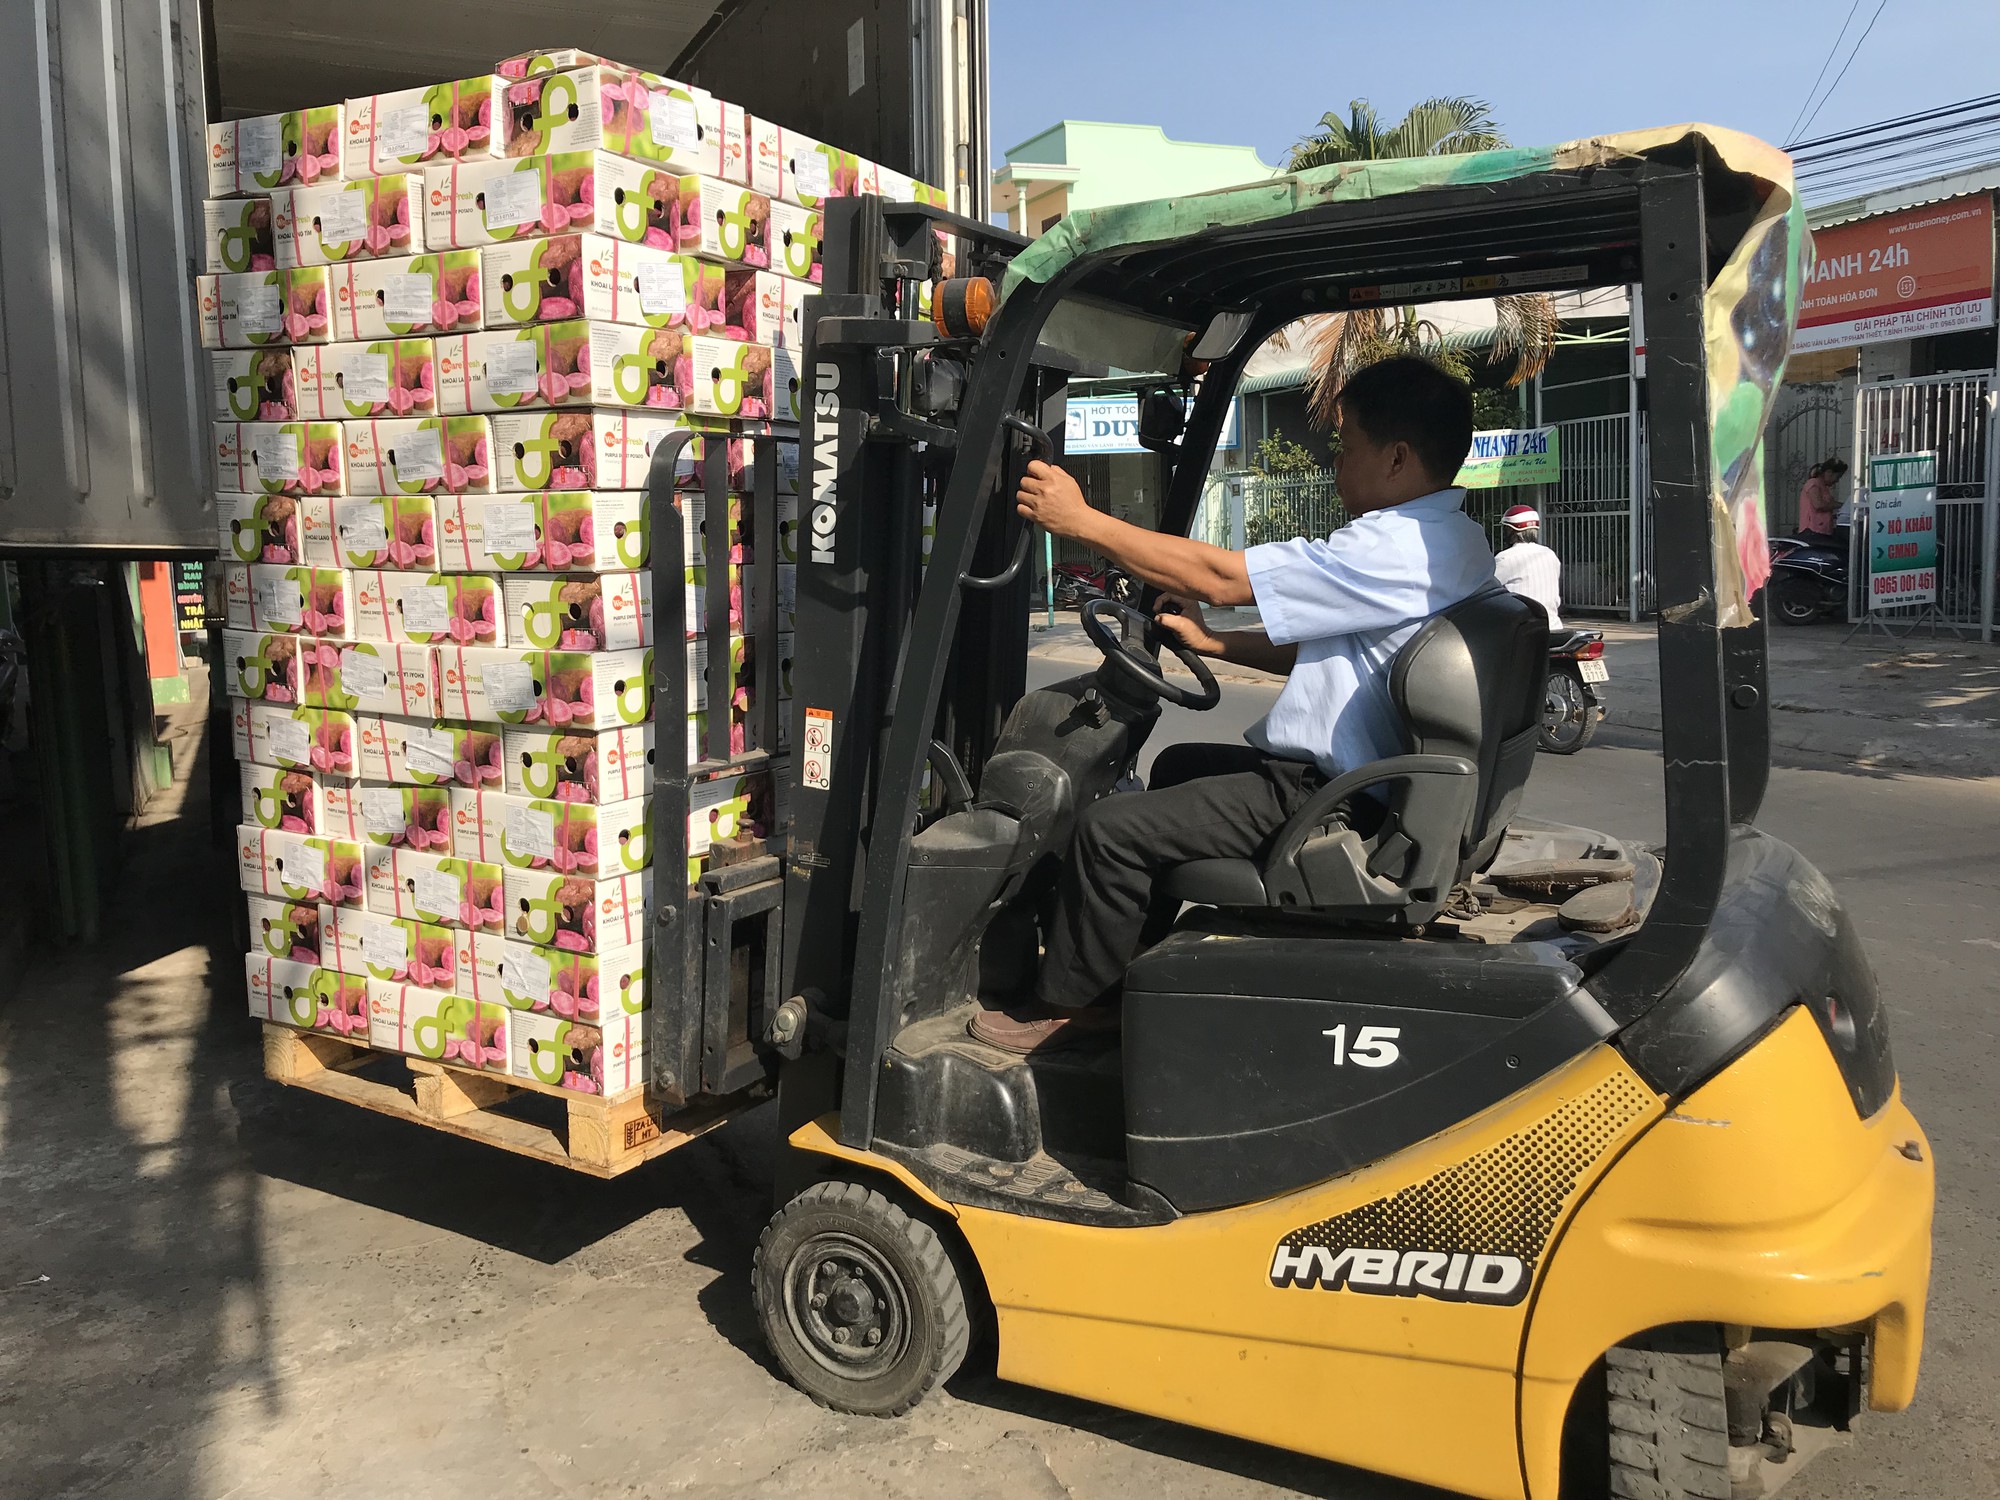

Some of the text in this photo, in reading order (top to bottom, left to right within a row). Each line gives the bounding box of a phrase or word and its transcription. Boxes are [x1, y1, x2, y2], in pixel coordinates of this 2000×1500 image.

[1888, 208, 1982, 234] www.truemoney.com.vn
[1869, 243, 1909, 272] 24h
[608, 283, 623, 293] LAG
[1816, 293, 1838, 307] TOÁN
[1839, 290, 1858, 303] HÓA
[1859, 288, 1878, 299] ĐƠN
[1874, 314, 1898, 327] PHÁP
[1916, 306, 1947, 321] CHÍNH
[1941, 319, 1956, 328] 0965
[1957, 317, 1969, 325] 001
[1970, 315, 1981, 323] 461
[458, 375, 472, 383] LAG
[1091, 405, 1136, 415] HỚT TÓC
[1472, 432, 1547, 458] NHANH 24h
[811, 362, 841, 564] KOMATSU
[1874, 464, 1895, 488] VAY
[1888, 543, 1918, 559] CMND
[1874, 572, 1934, 594] 0965 001 461
[1322, 1024, 1400, 1068] 15
[642, 1129, 652, 1140] HT
[1271, 1245, 1523, 1294] HYBRID
